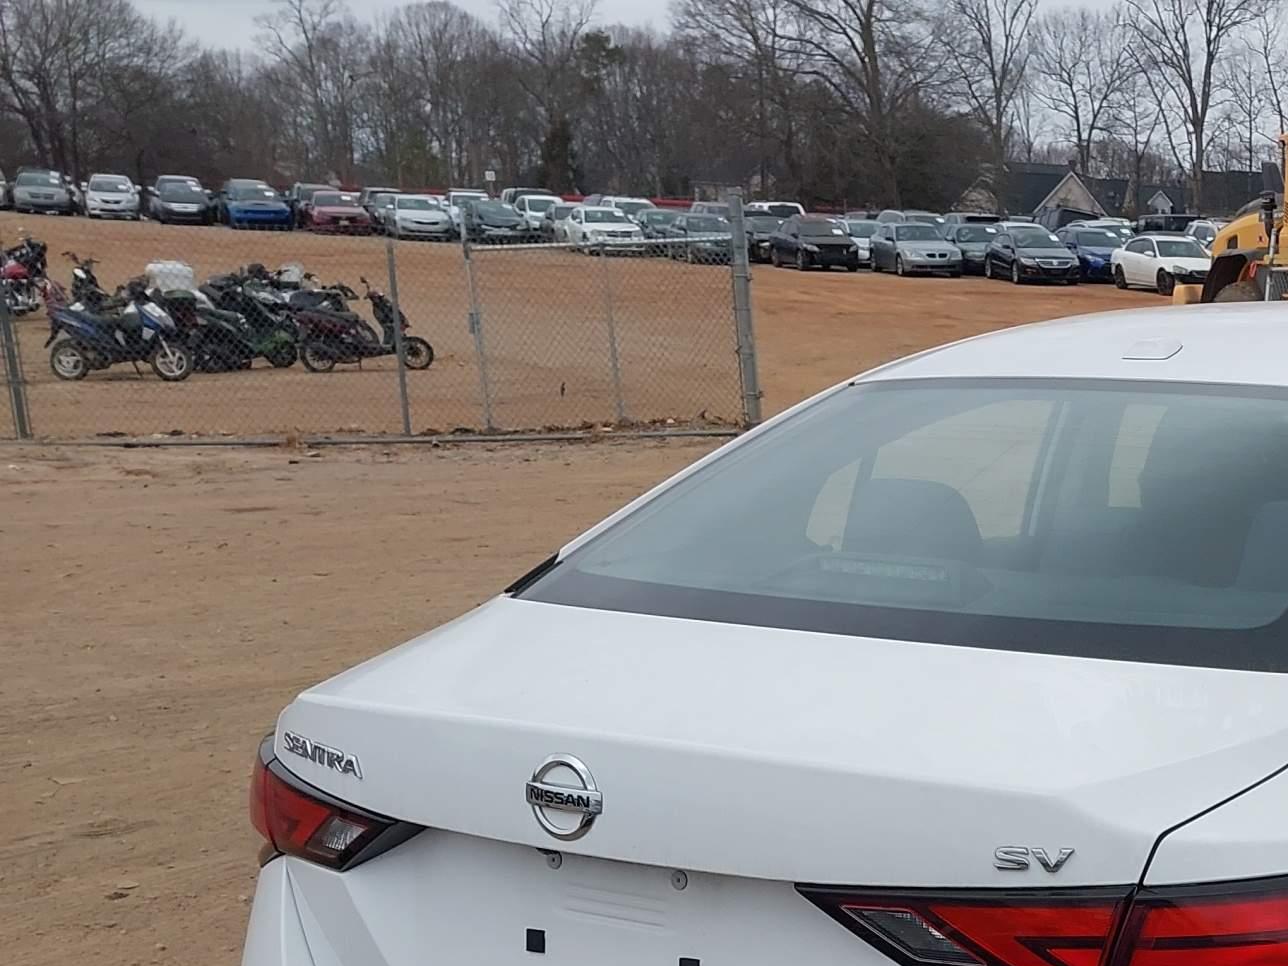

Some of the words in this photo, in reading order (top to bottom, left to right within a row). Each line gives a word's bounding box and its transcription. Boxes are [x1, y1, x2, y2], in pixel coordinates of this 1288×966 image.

[283, 730, 363, 780] SENTRA
[530, 787, 590, 808] NISSAN
[993, 845, 1075, 873] SV
